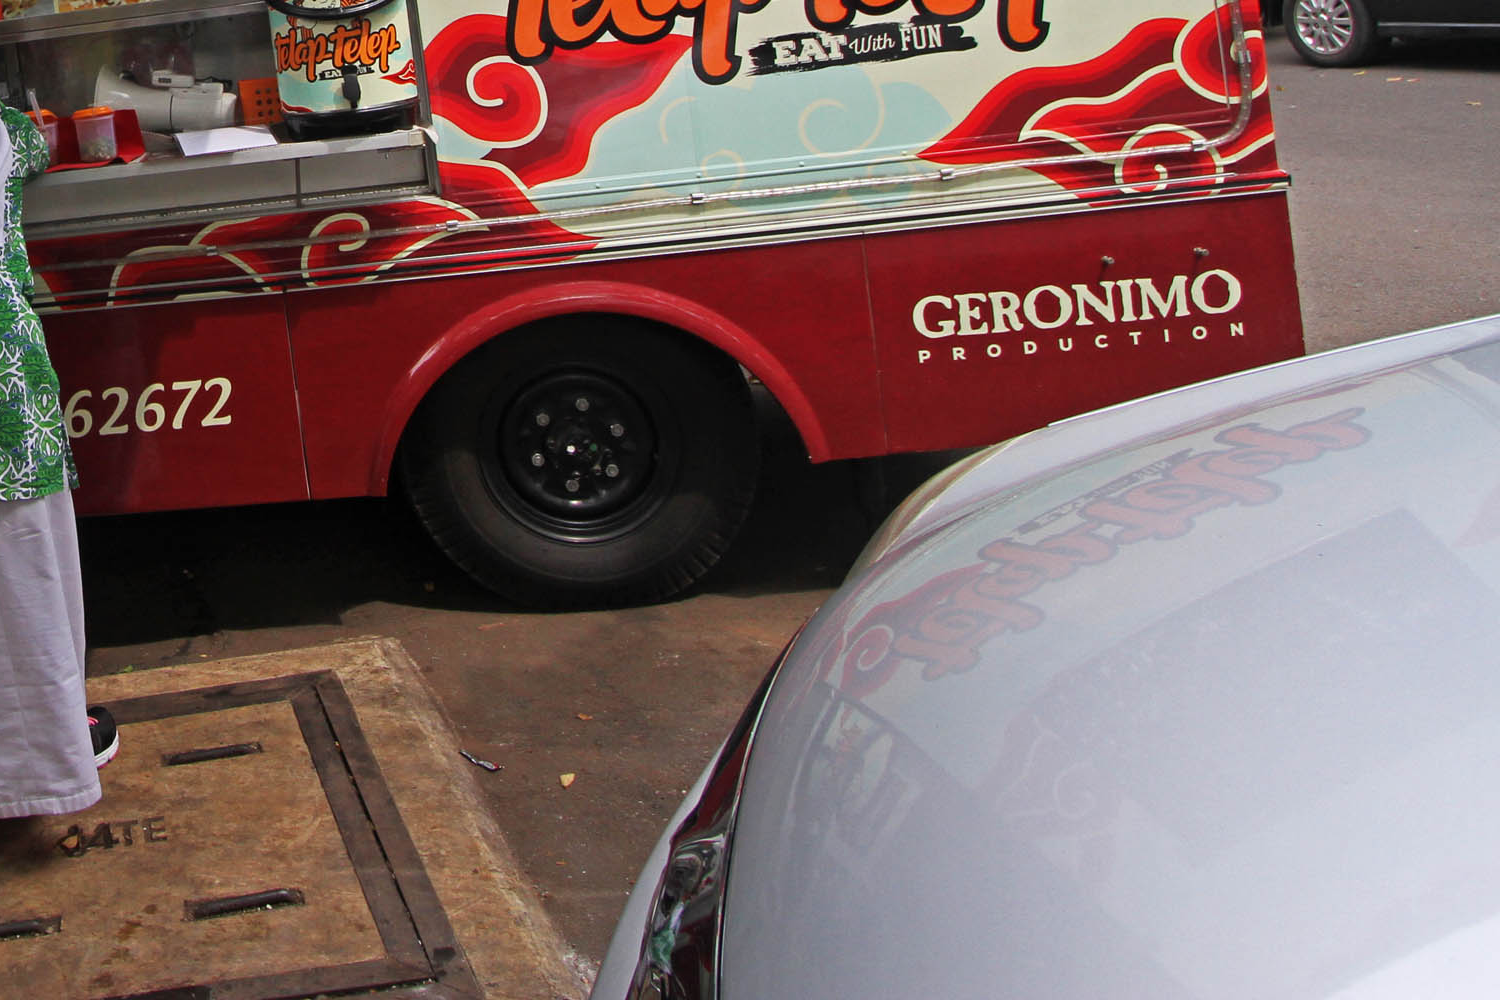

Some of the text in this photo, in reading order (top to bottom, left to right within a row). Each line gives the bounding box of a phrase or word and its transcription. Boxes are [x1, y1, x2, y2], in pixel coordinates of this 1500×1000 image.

[773, 24, 943, 65] EAT With FUN
[913, 269, 1241, 339] GERONIMO
[918, 322, 1244, 363] PRODUCTION
[64, 377, 232, 438] 62672
